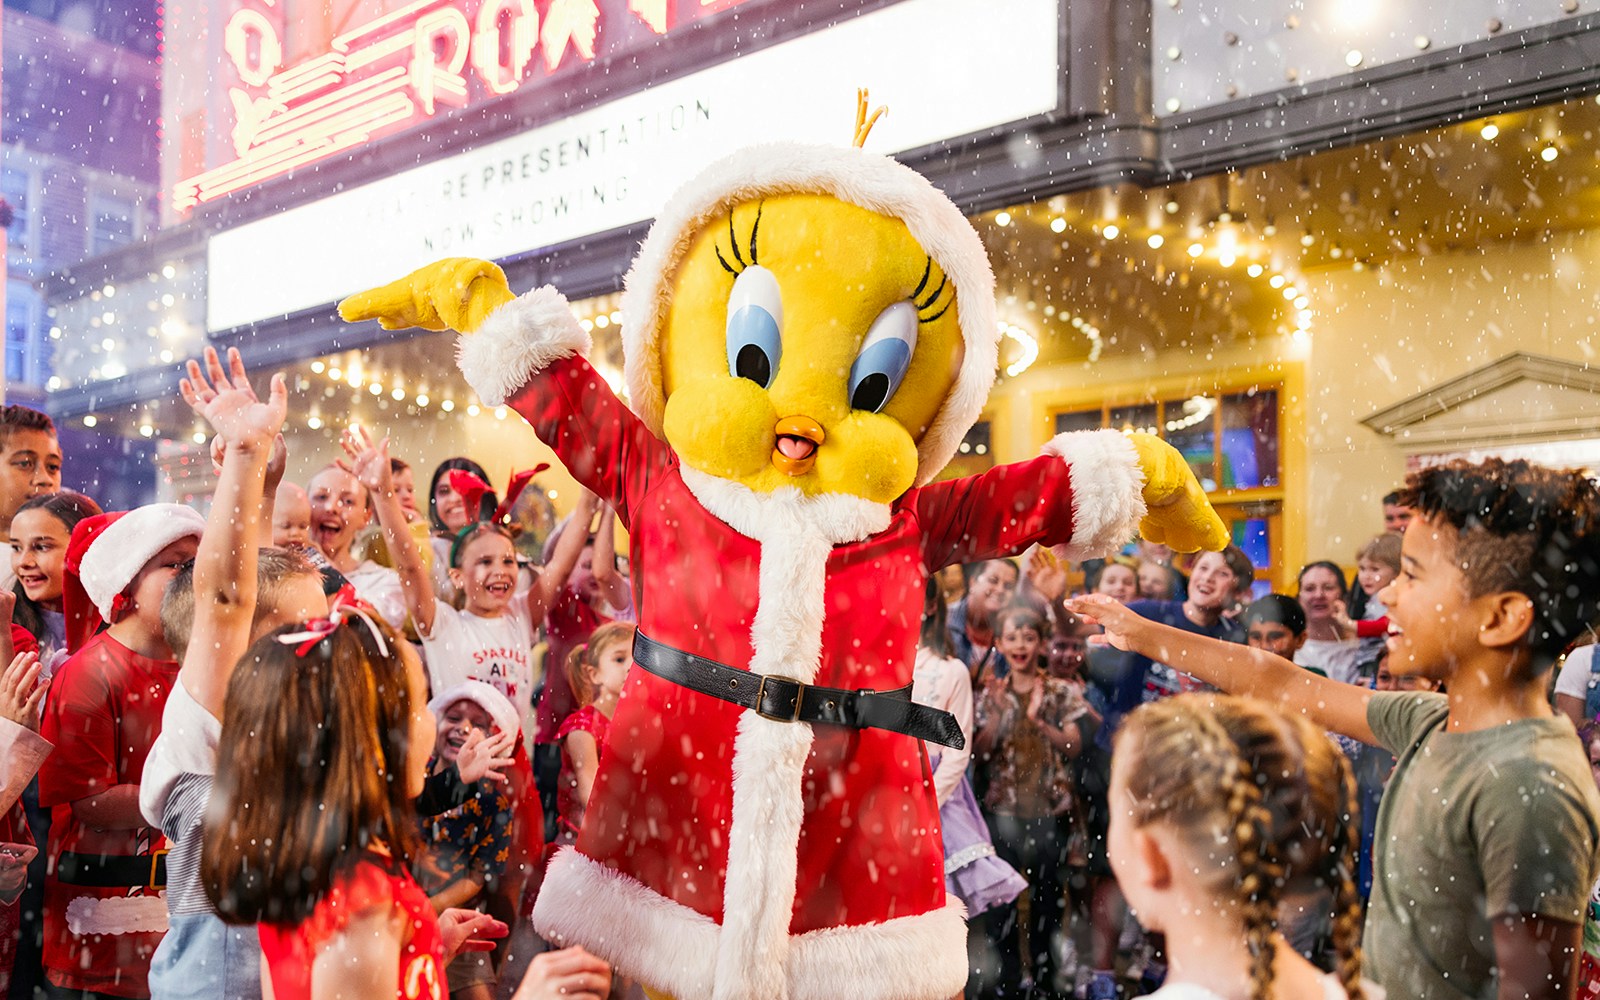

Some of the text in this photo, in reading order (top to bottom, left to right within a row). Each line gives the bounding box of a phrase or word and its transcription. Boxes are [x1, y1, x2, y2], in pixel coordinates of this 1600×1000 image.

[482, 97, 710, 190] PRESENTATION
[423, 175, 627, 251] NOW SHOWING
